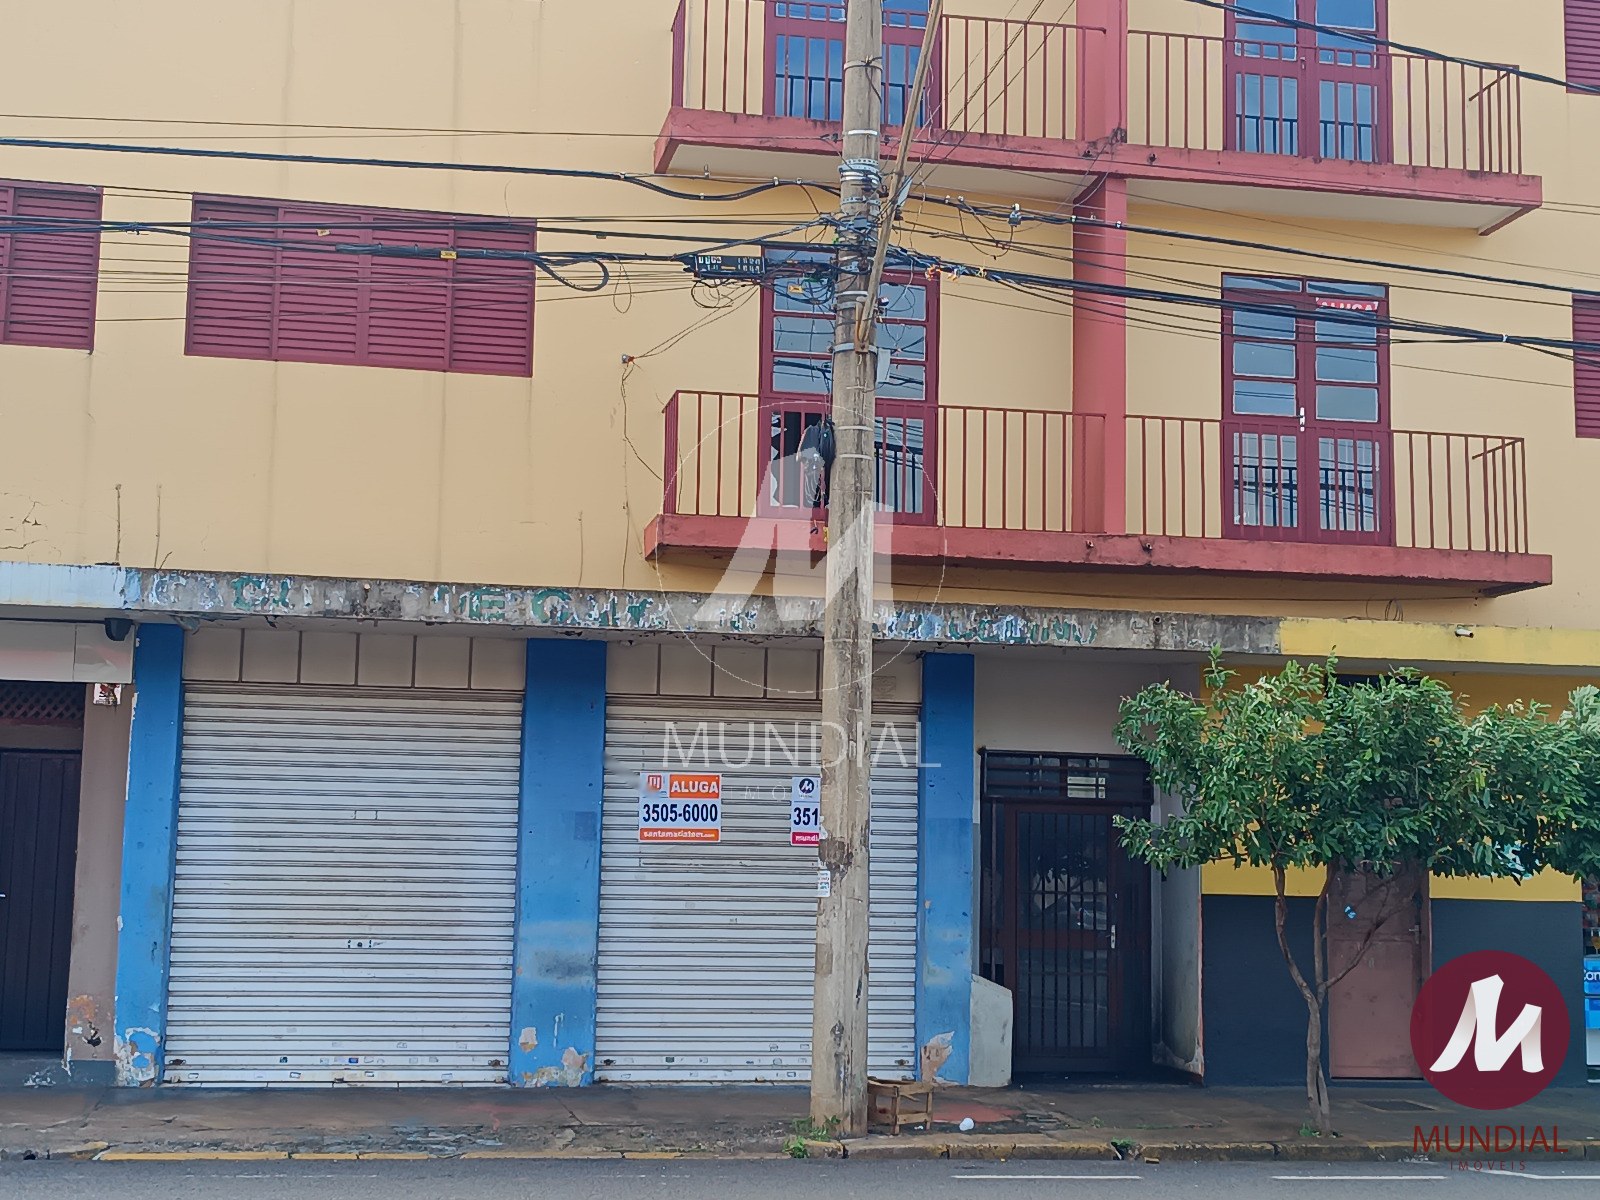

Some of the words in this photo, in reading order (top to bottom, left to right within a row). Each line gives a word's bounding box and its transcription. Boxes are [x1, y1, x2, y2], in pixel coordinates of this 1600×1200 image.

[670, 780, 719, 794] ALUGA
[642, 803, 719, 823] 3505-6000
[793, 807, 819, 826] 351
